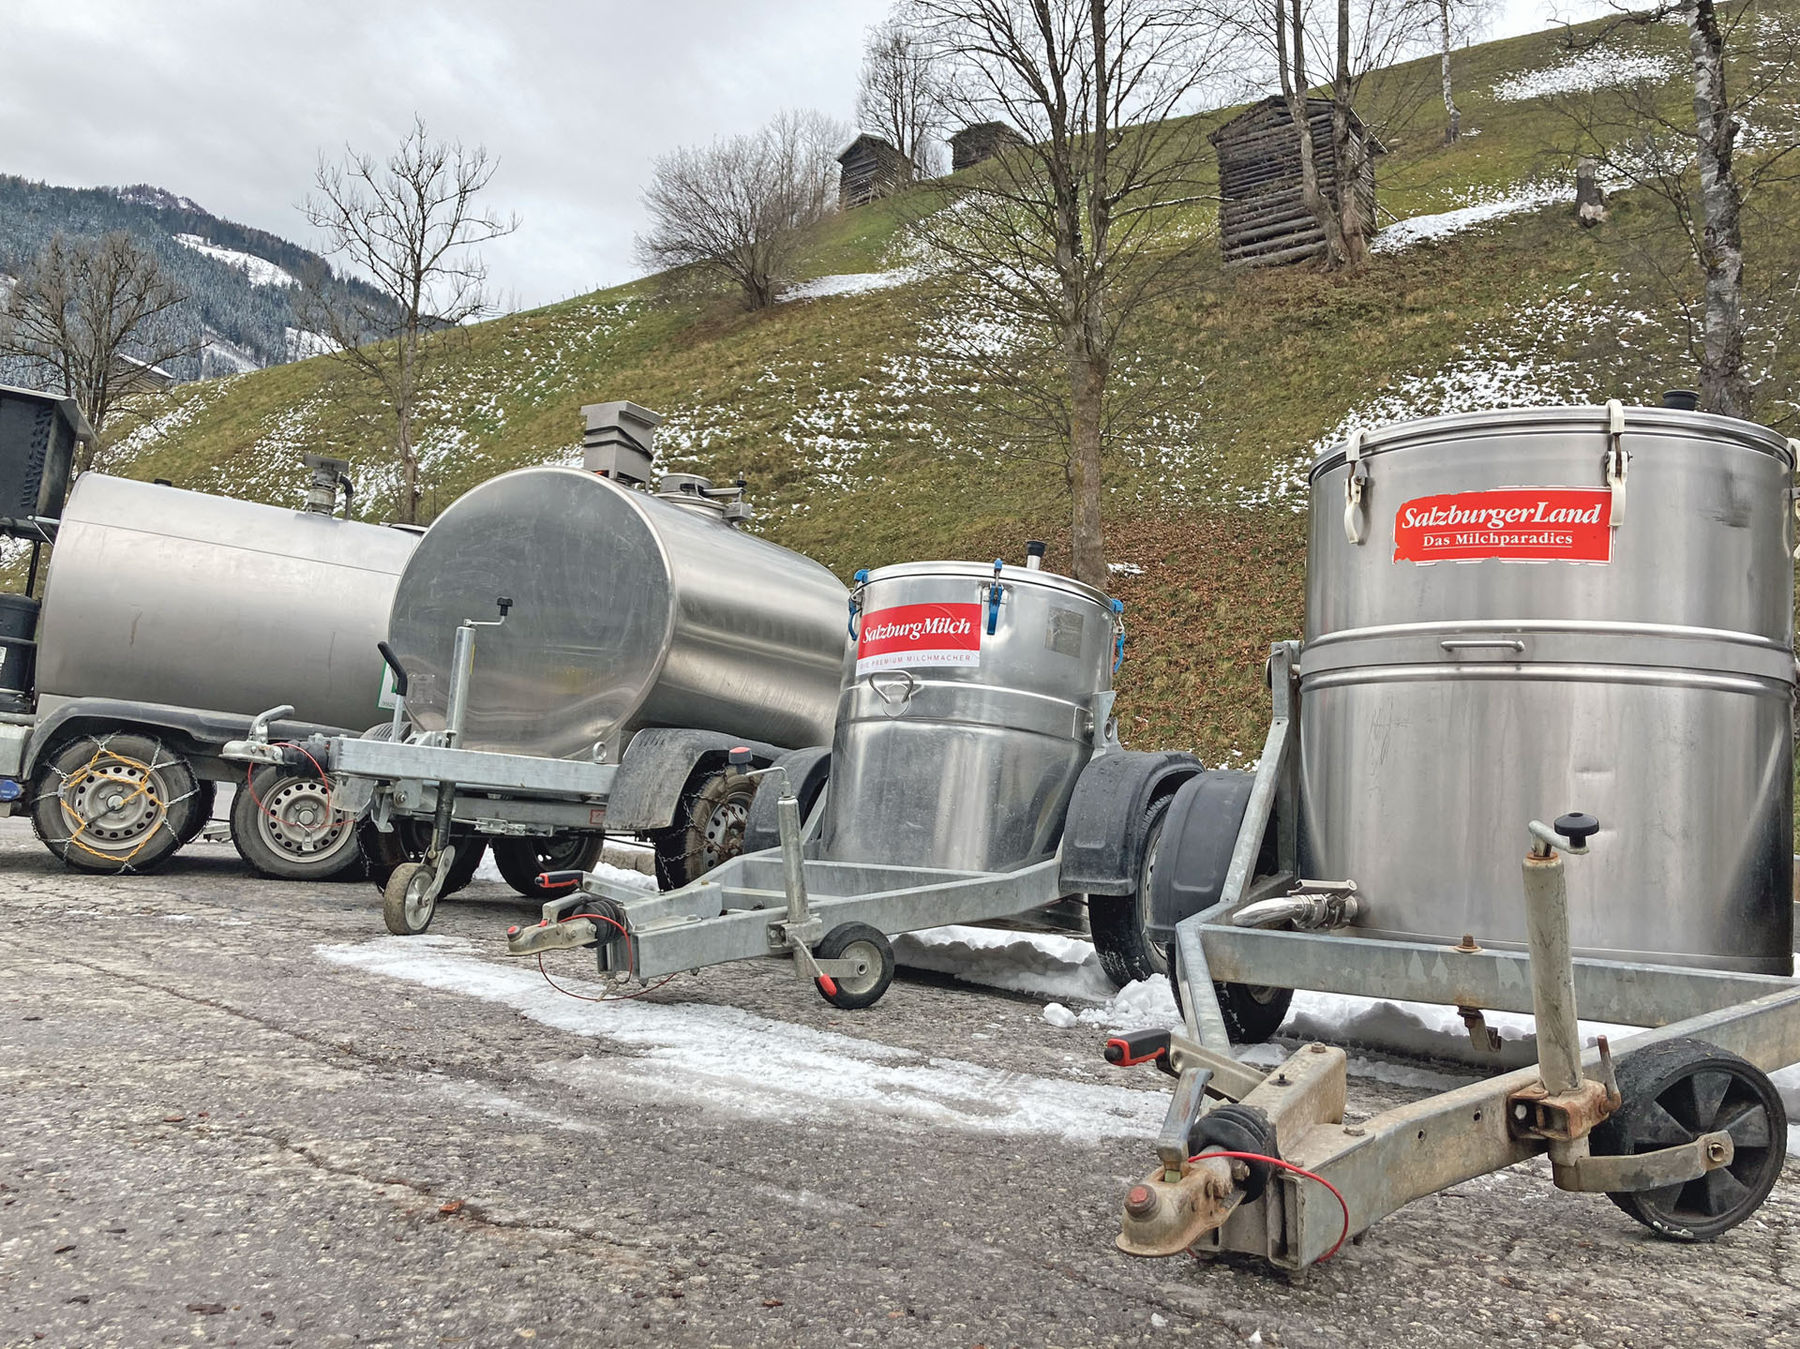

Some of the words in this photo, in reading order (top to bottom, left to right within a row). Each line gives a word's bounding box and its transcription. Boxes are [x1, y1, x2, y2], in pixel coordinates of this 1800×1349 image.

[1402, 501, 1602, 529] SalzburgerLand
[1423, 535, 1450, 547] Das
[1455, 532, 1573, 547] Milchparadies
[863, 617, 971, 643] SalzburgMilch
[871, 657, 903, 667] PREMIUM
